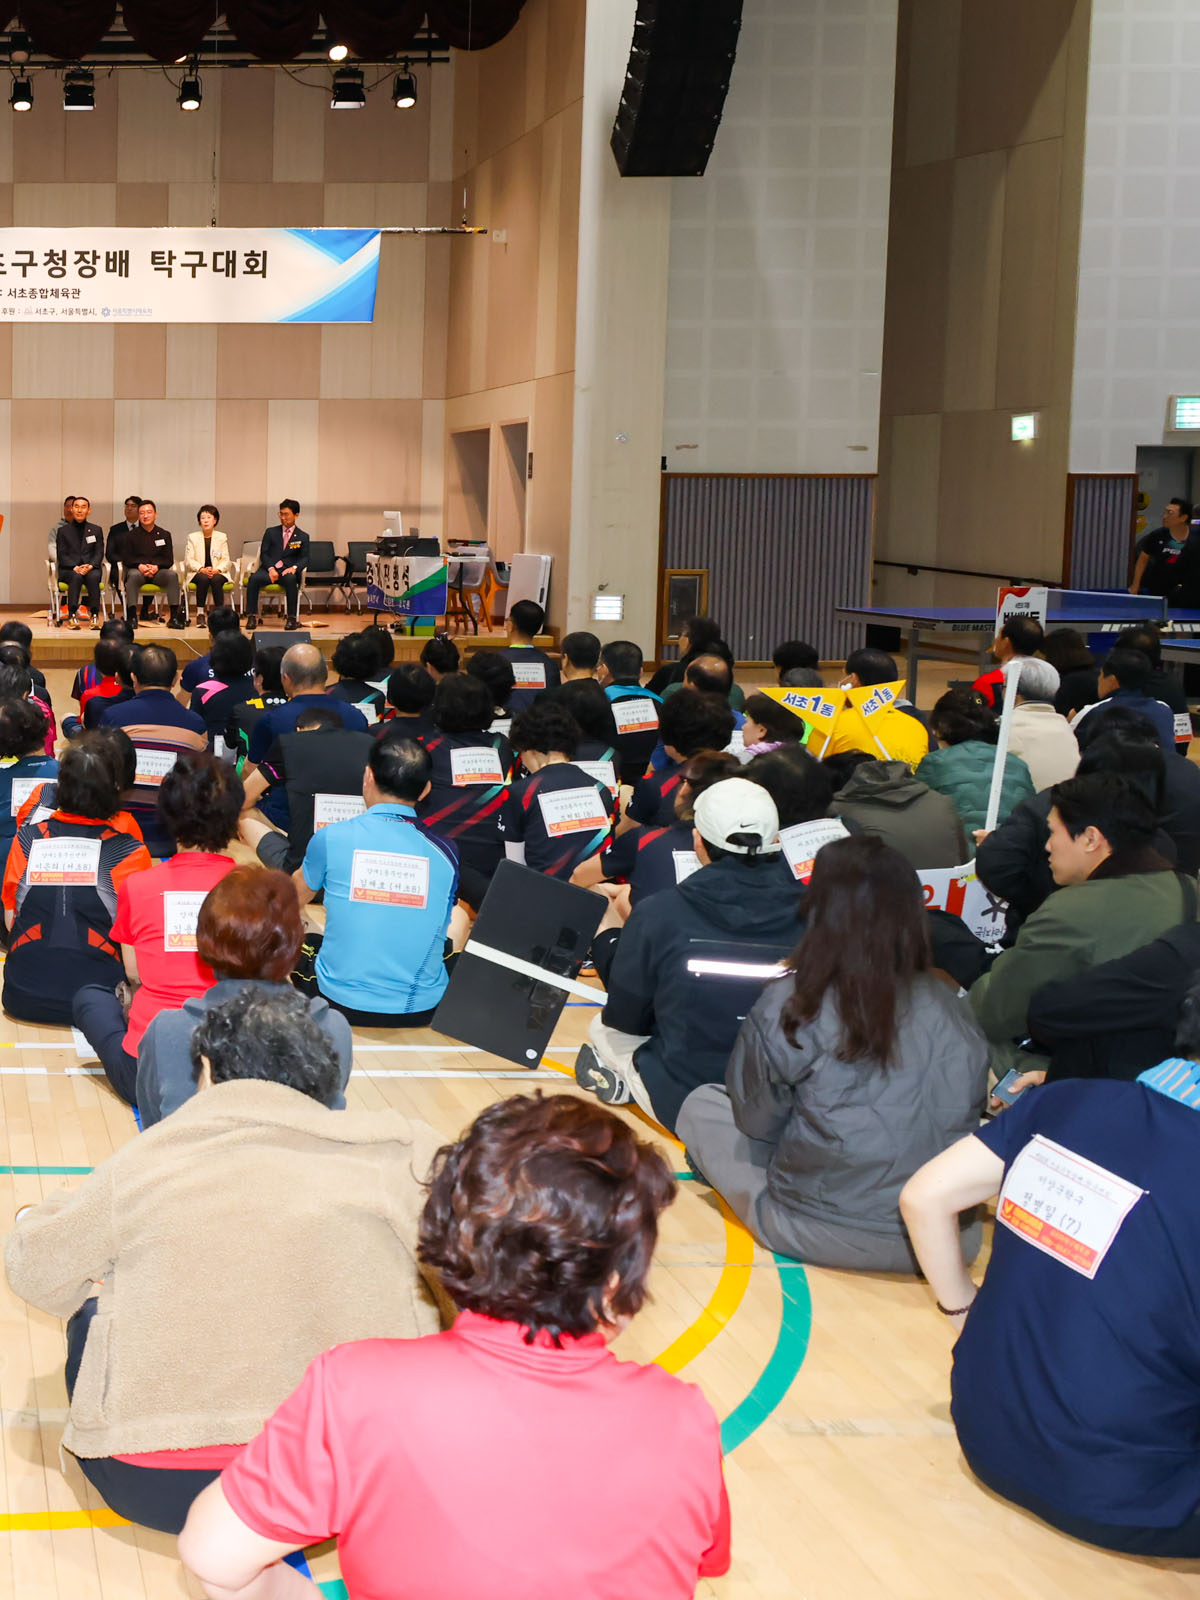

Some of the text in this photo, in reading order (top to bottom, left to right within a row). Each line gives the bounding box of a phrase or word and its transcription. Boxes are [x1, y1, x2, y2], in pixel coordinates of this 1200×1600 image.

[150, 249, 269, 278] 탁구대회
[7, 287, 81, 299] 서초종합체육관
[1059, 1213, 1082, 1236] (7)
